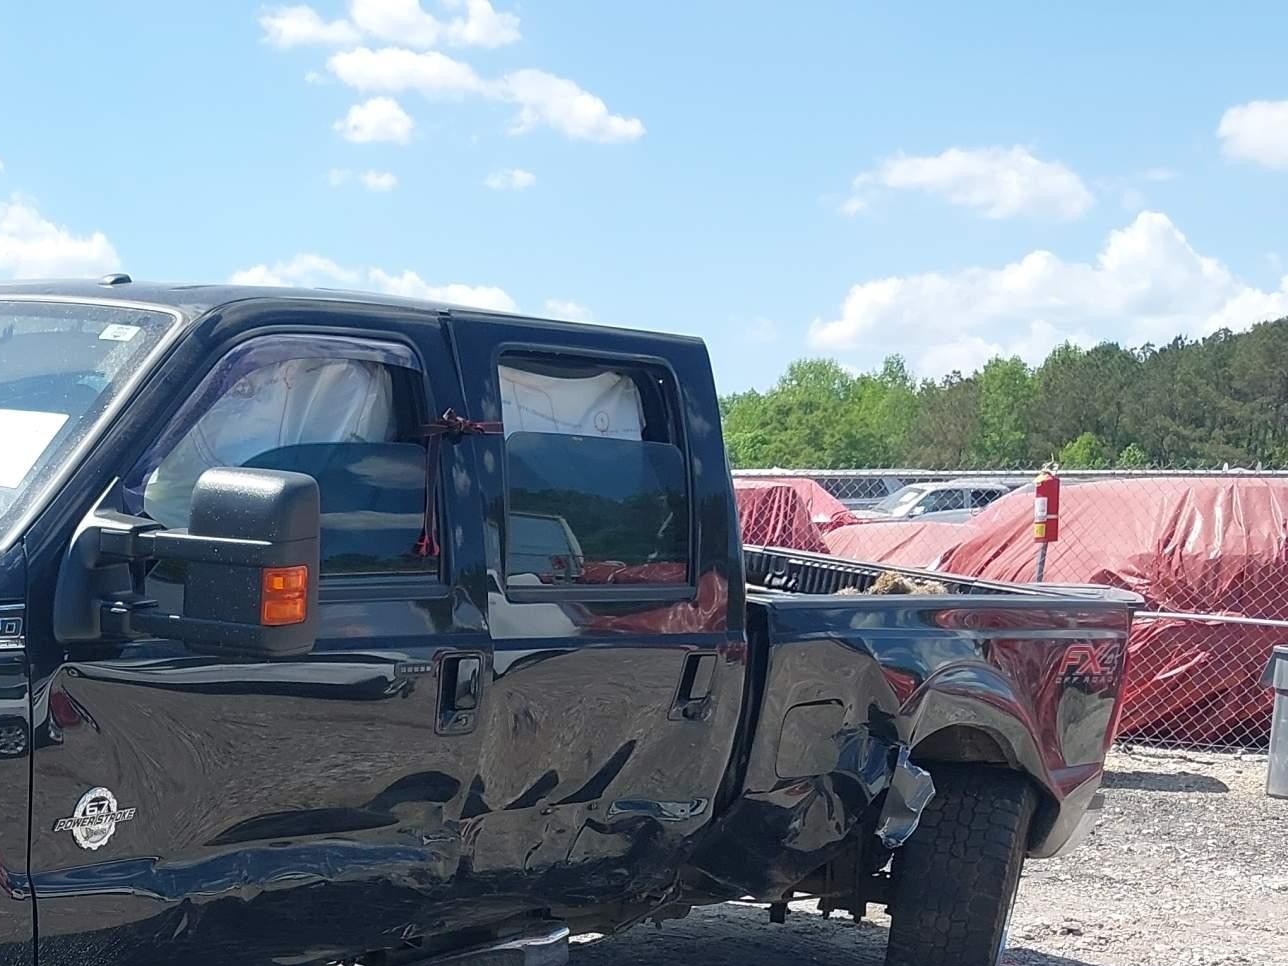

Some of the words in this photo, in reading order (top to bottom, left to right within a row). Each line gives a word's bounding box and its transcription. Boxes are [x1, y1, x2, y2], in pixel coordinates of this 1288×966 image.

[1058, 643, 1121, 675] FX4
[56, 815, 97, 830] POWER
[96, 808, 136, 826] STROKE
